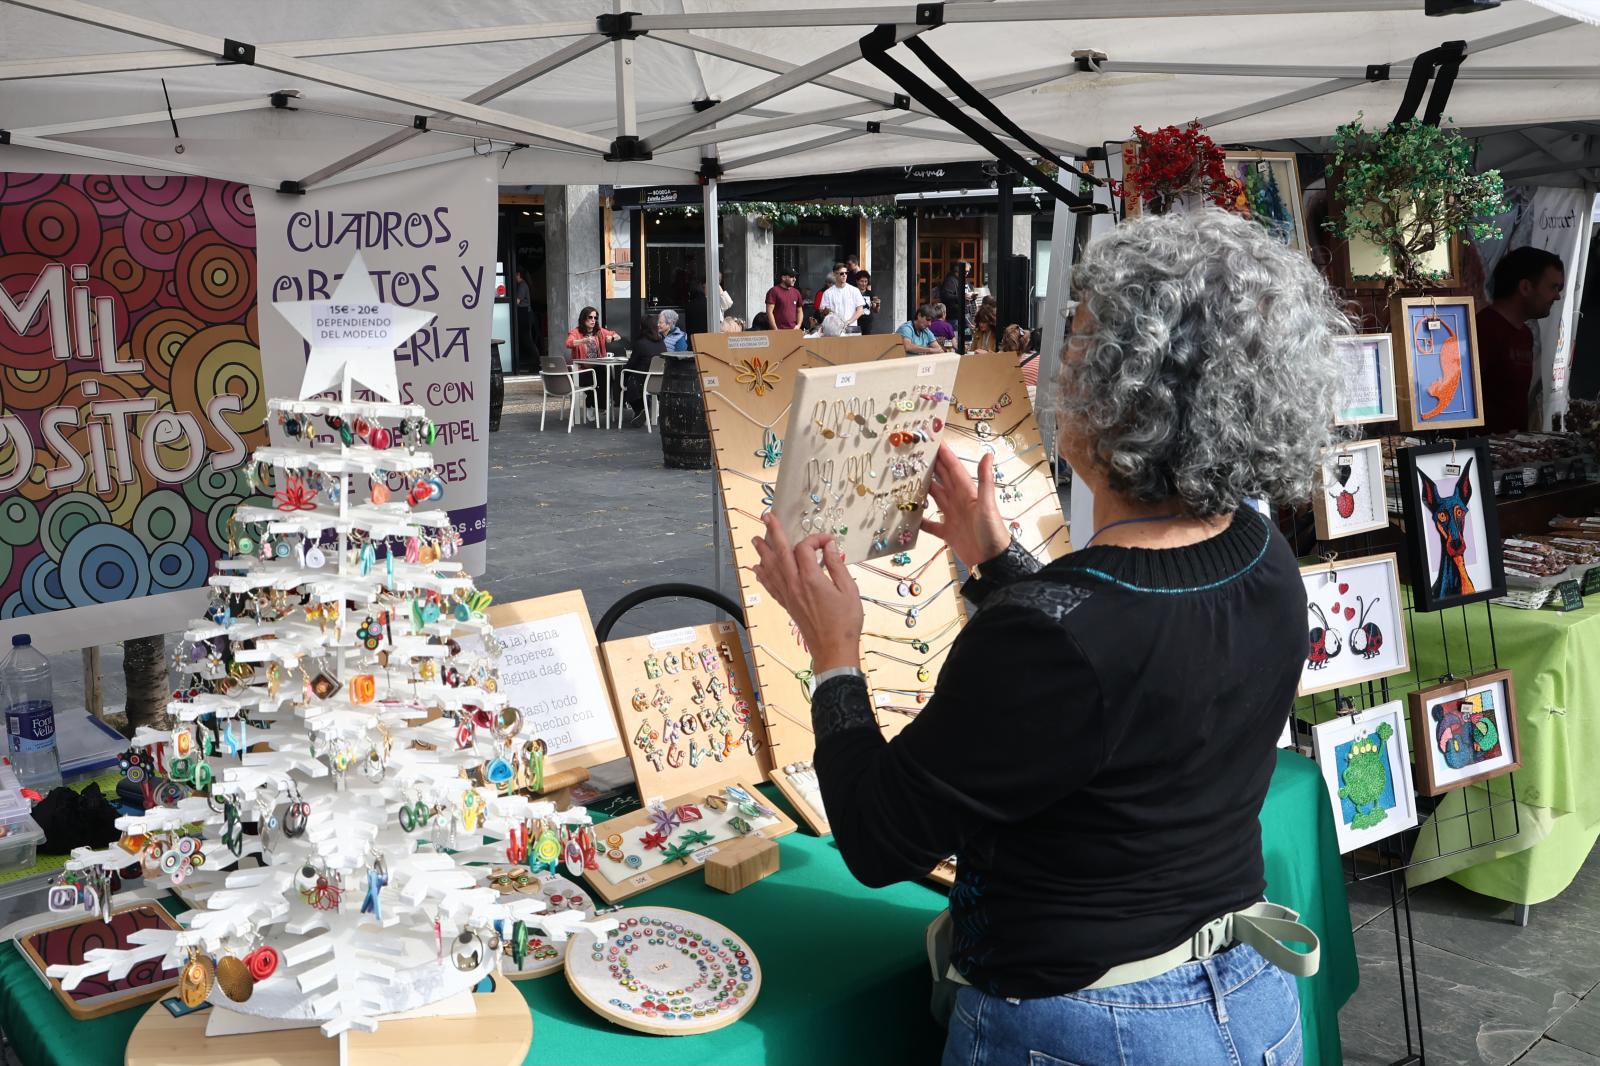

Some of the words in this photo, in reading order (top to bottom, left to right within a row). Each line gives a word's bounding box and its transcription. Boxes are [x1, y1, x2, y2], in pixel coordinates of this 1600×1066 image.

[287, 207, 469, 257] CUADROS,
[272, 264, 439, 307] OBTOS
[330, 305, 349, 314] 15€
[358, 305, 379, 314] 20€
[316, 318, 391, 327] DEPENDIENDO
[321, 330, 340, 339] DEL
[342, 329, 387, 339] MODELO
[427, 381, 474, 406] CON
[434, 419, 480, 447] APEL
[529, 628, 560, 643] dena
[505, 647, 555, 666] Paperez
[501, 669, 538, 686] Egina
[539, 661, 568, 678] dago
[552, 694, 578, 710] todo
[573, 708, 594, 722] con
[546, 731, 572, 749] apel
